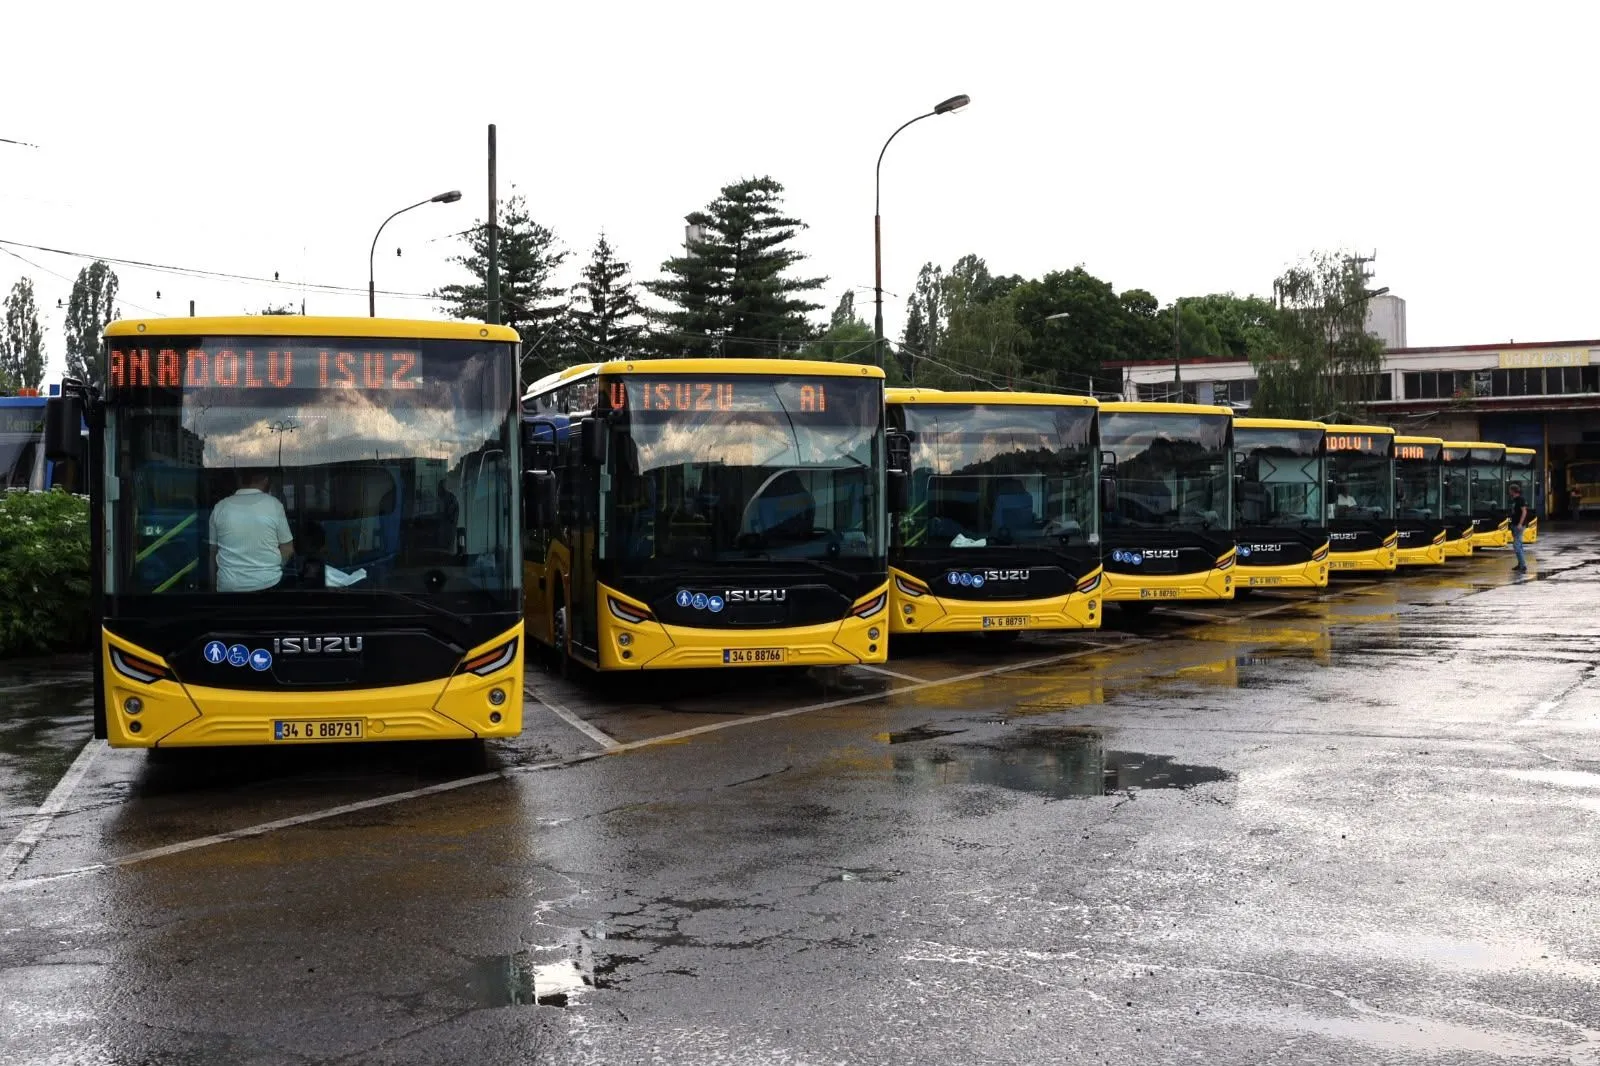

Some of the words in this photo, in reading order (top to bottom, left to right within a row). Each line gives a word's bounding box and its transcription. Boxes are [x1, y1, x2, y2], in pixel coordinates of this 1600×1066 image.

[110, 349, 293, 388] ANADOLU
[318, 351, 416, 389] ISUZ
[642, 383, 734, 411] ISUZU
[1329, 532, 1357, 540] ISUZU
[1142, 549, 1179, 559] ISUZU
[1250, 544, 1282, 552] ISUZU
[984, 570, 1030, 581] ISUZU
[725, 589, 786, 602] ISUZU
[273, 636, 363, 654] ISUZU
[733, 651, 745, 662] 34
[746, 650, 753, 661] G
[754, 650, 781, 661] 88766
[283, 723, 299, 738] 34
[305, 723, 313, 737] G
[319, 722, 361, 737] 88791
